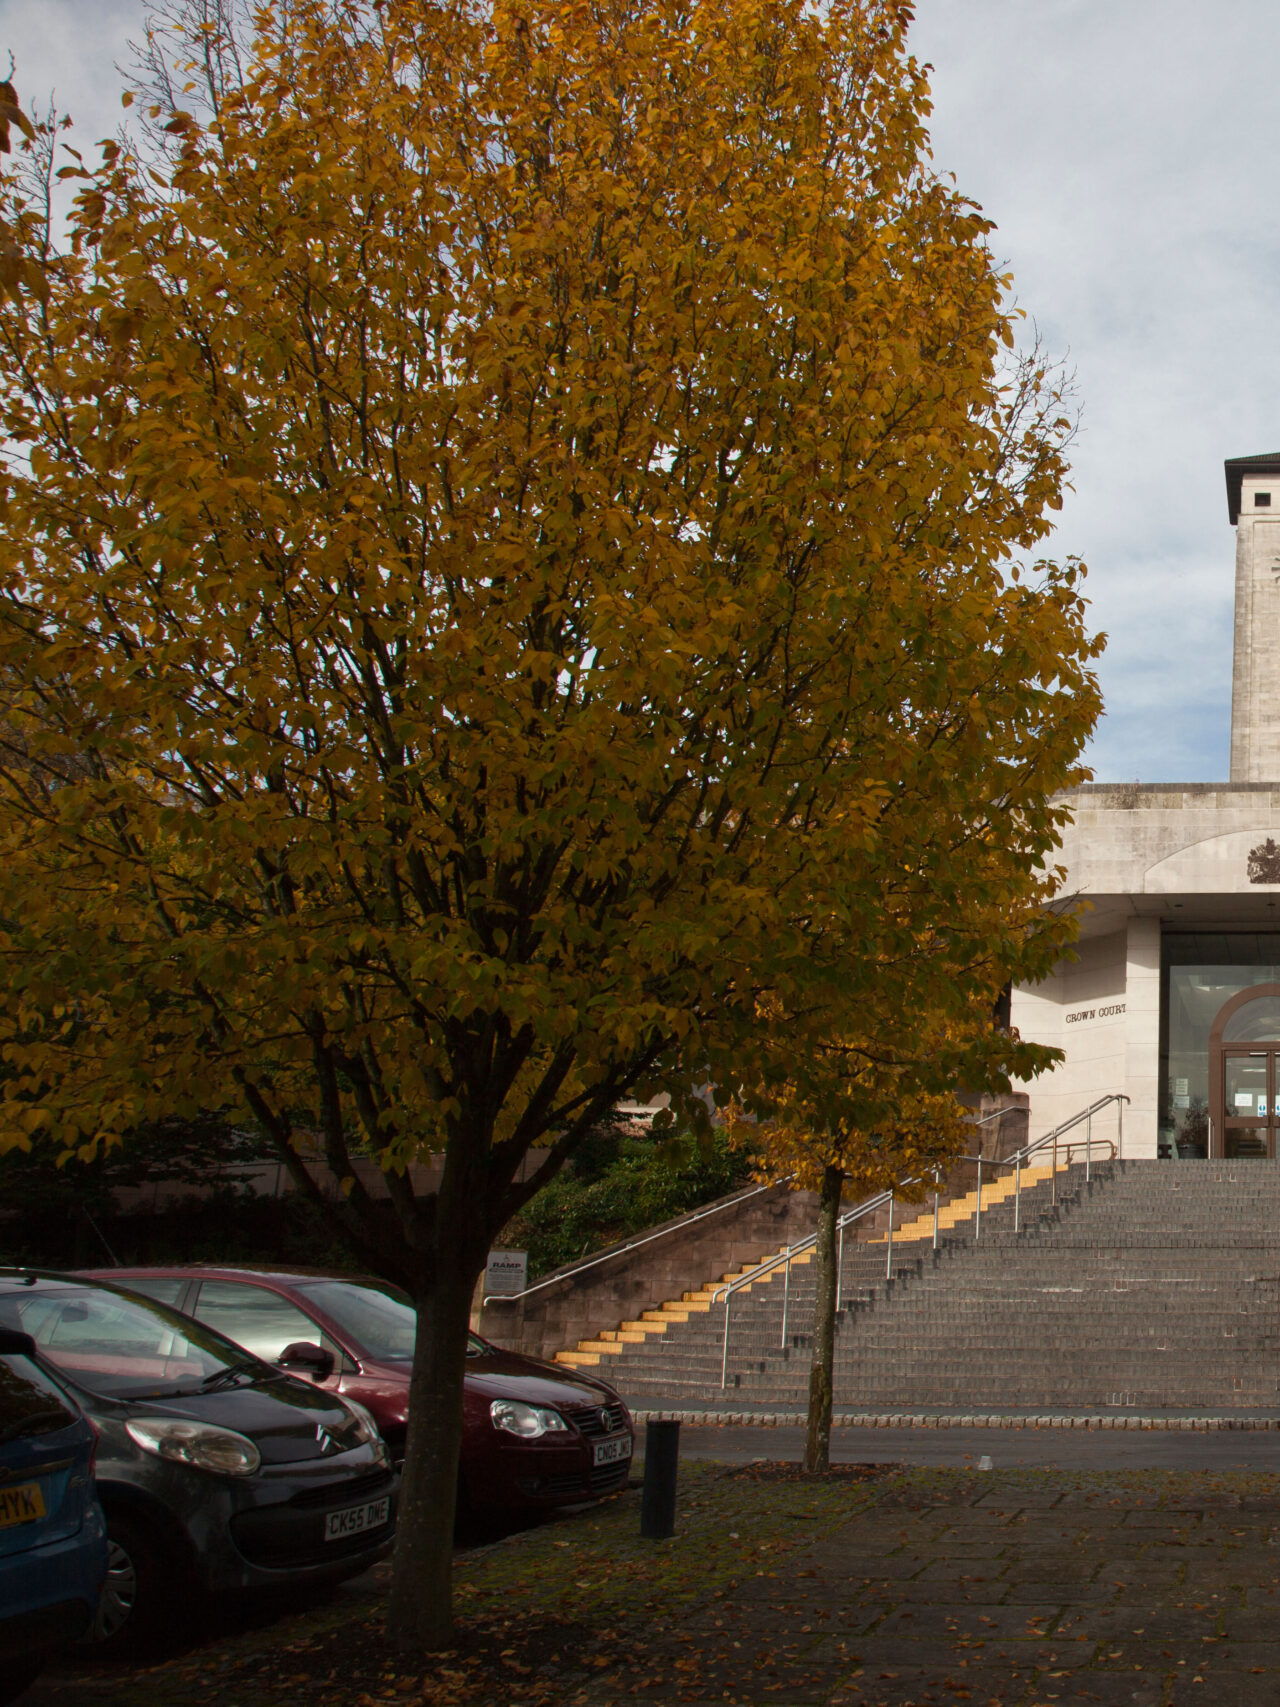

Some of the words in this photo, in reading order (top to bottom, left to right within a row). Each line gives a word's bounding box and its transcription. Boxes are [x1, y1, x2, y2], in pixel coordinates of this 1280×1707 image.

[1065, 1009, 1096, 1024] CROWN
[1098, 1003, 1127, 1018] COURT
[330, 1507, 365, 1535] CK55
